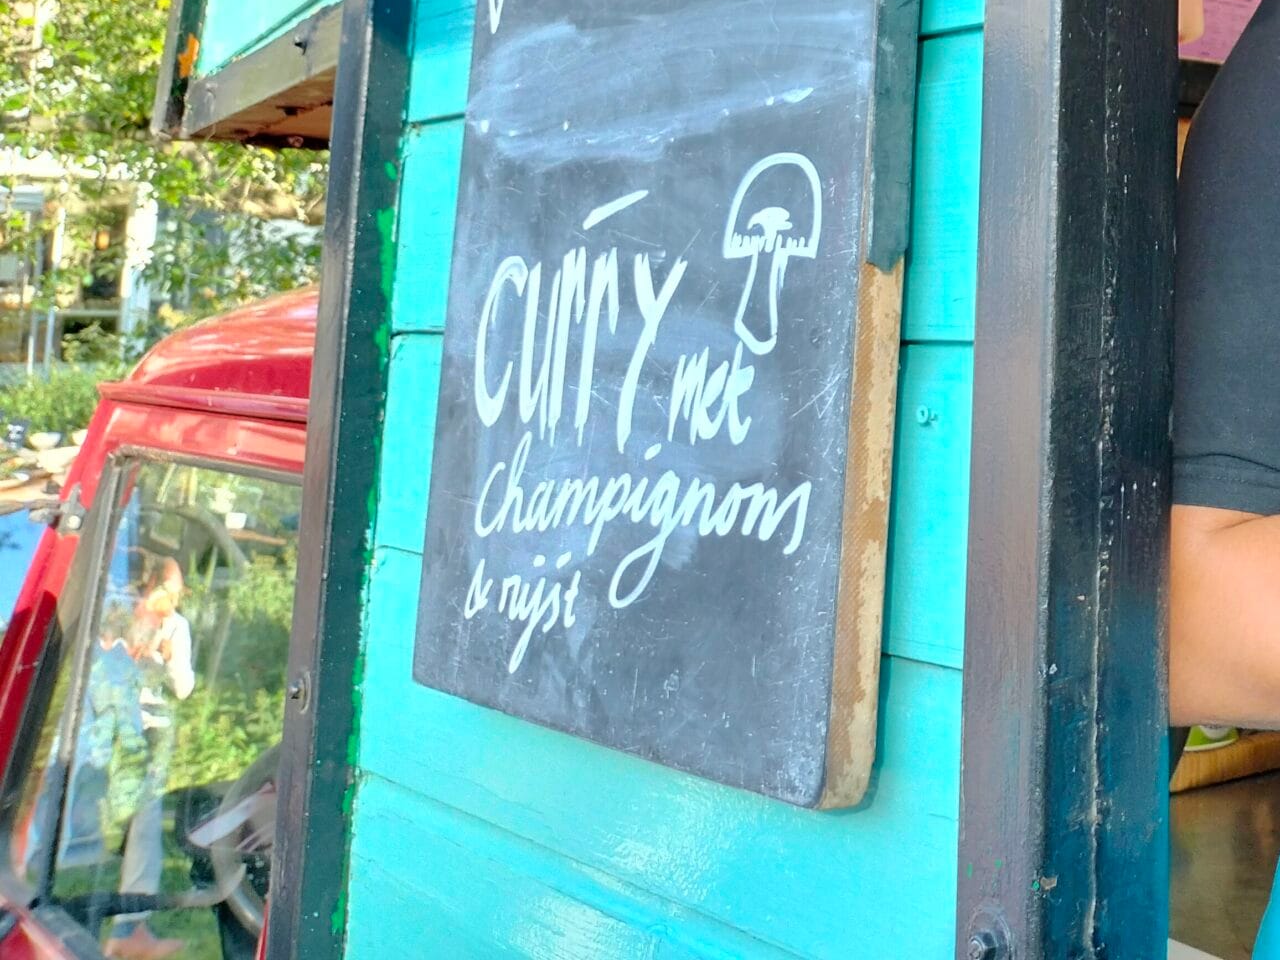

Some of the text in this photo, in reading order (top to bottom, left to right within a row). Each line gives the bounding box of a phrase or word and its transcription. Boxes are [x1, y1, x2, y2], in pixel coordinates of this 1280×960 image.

[667, 343, 755, 444] met
[474, 432, 811, 608] champignons
[498, 551, 581, 674] rijst
